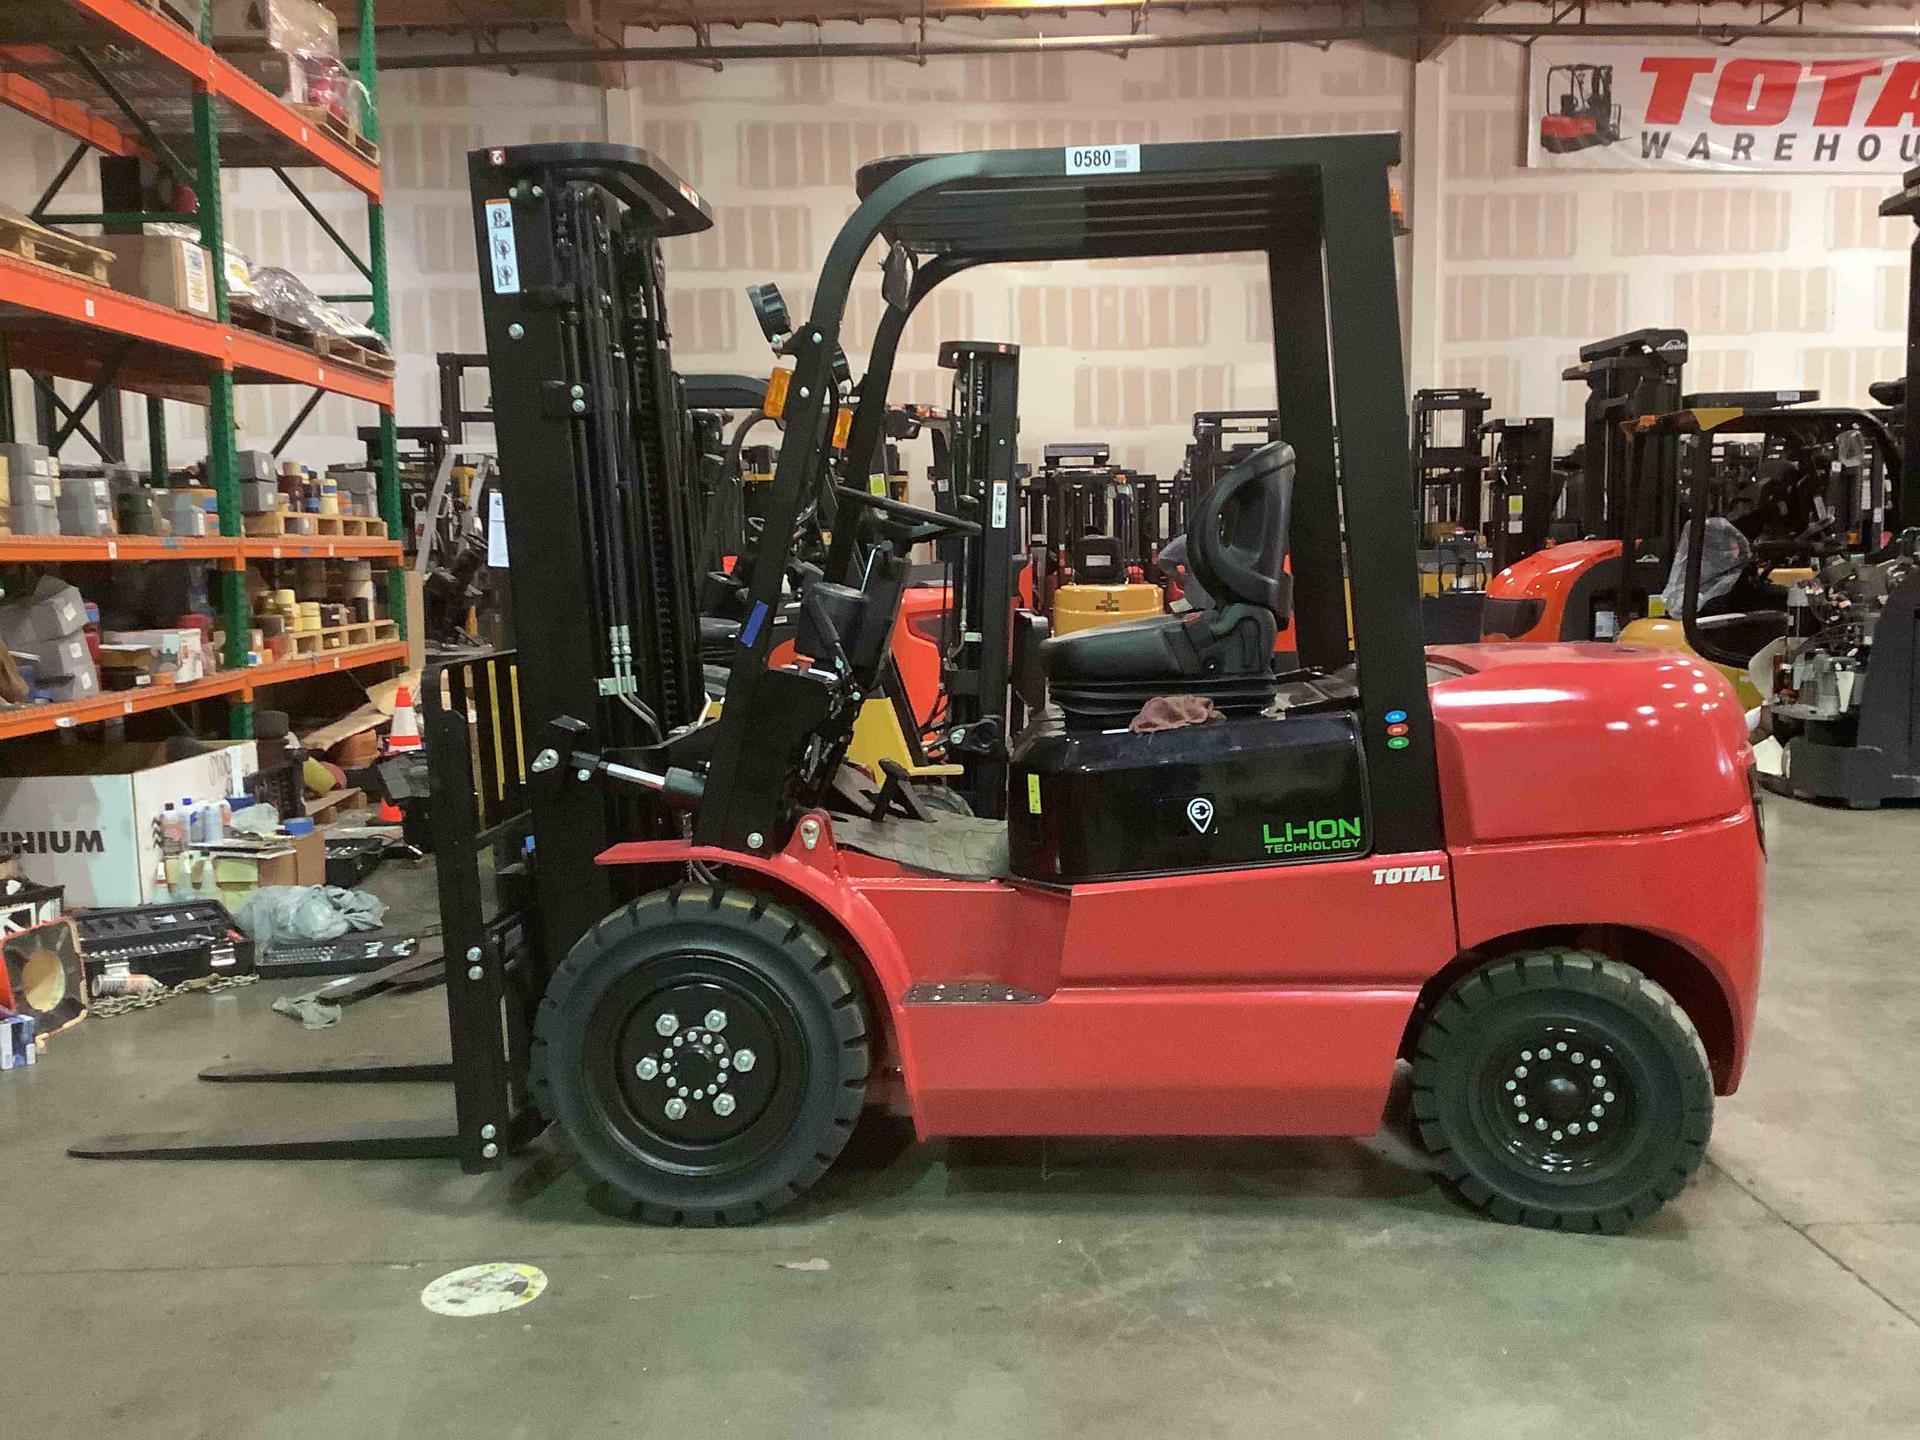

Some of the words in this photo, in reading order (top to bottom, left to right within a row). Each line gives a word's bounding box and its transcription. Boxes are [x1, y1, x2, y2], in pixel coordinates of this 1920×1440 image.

[1640, 57, 1920, 127] TOTA
[1074, 149, 1111, 168] 0580
[1641, 131, 1920, 162] WAREHOU
[1263, 817, 1361, 844] LI-ION
[1264, 838, 1361, 854] TECHNOLOGY
[1372, 864, 1445, 886] TOTAL
